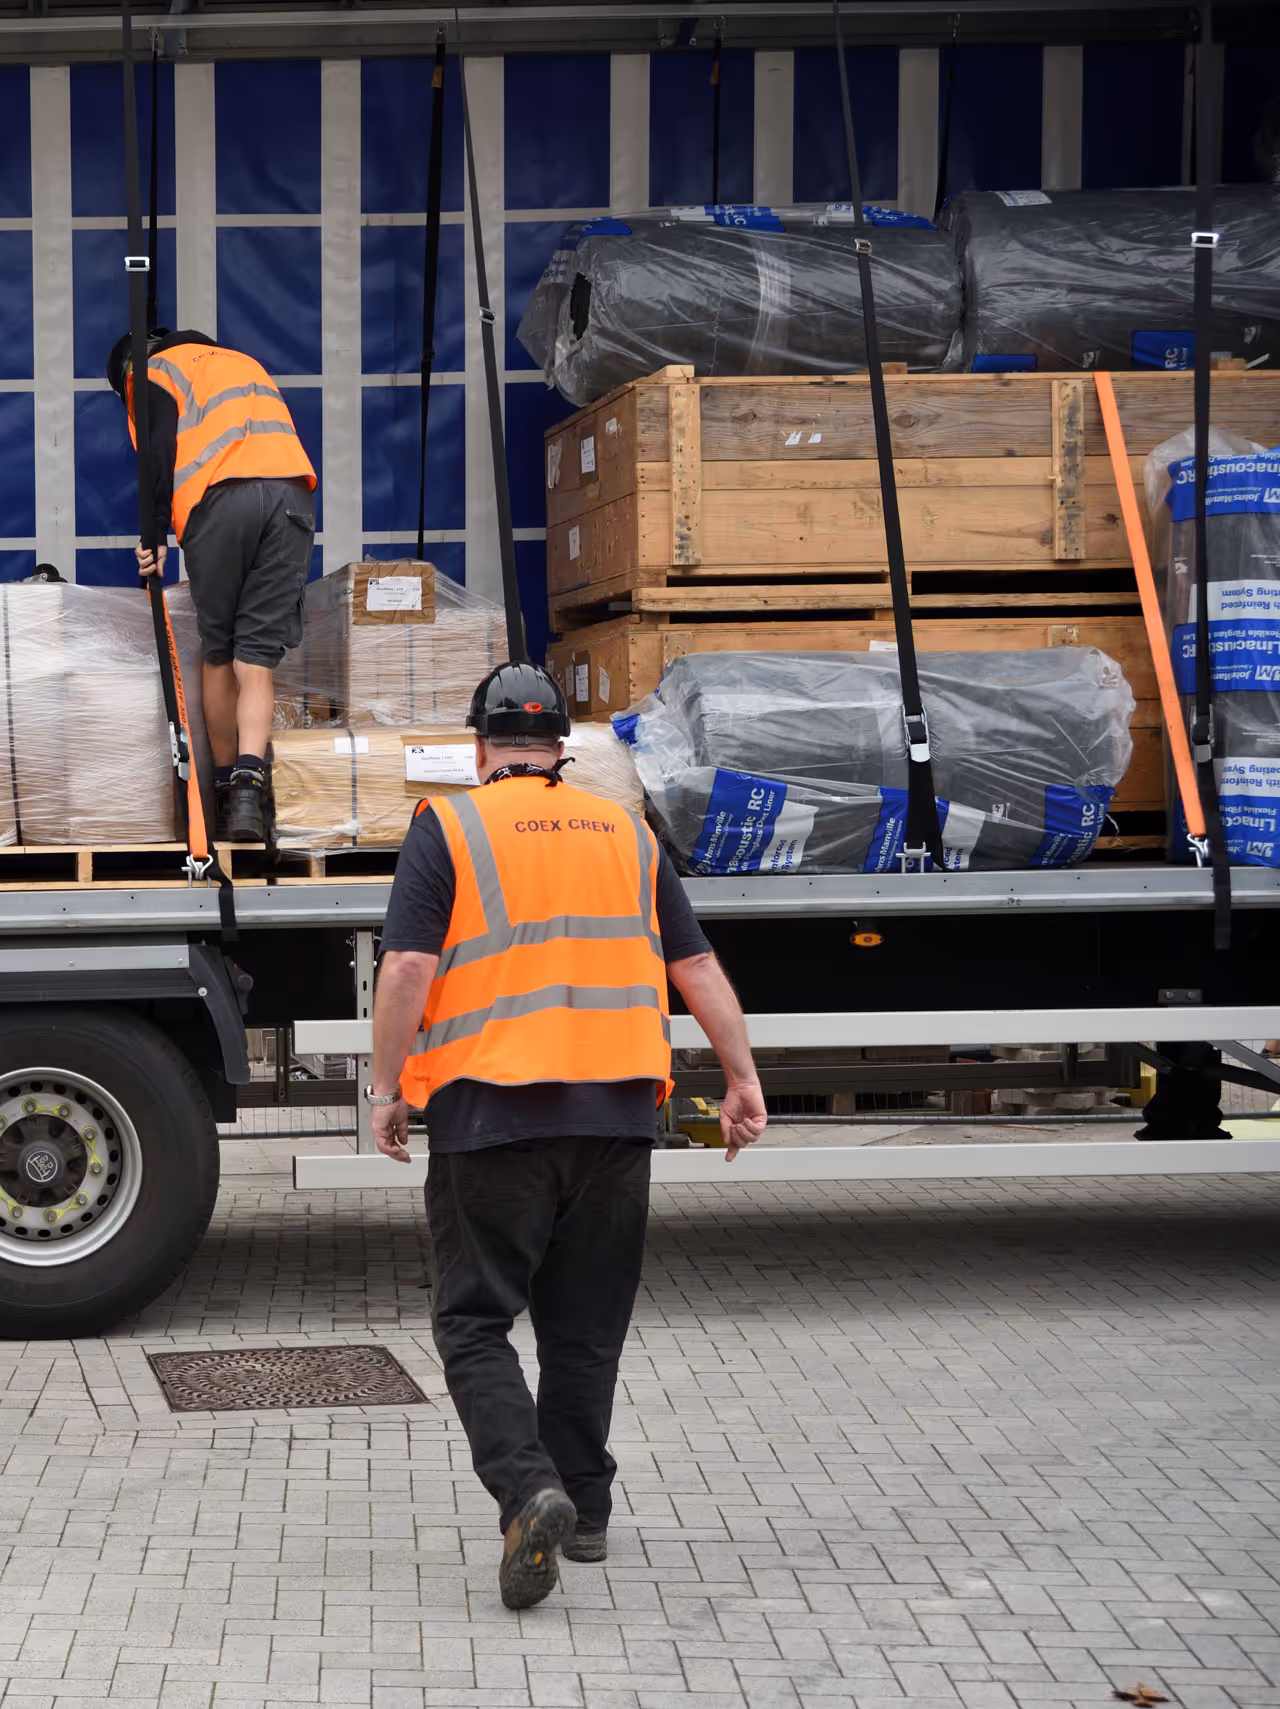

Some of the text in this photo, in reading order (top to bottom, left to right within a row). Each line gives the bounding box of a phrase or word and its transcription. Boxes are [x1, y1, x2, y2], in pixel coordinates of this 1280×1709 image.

[1249, 764, 1280, 777] oating
[1266, 778, 1280, 788] ith
[747, 787, 765, 811] RC
[763, 790, 776, 812] Liner
[515, 818, 615, 834] COEX CREW
[1081, 803, 1096, 827] RC
[881, 817, 896, 853] Manville
[784, 839, 799, 870] System
